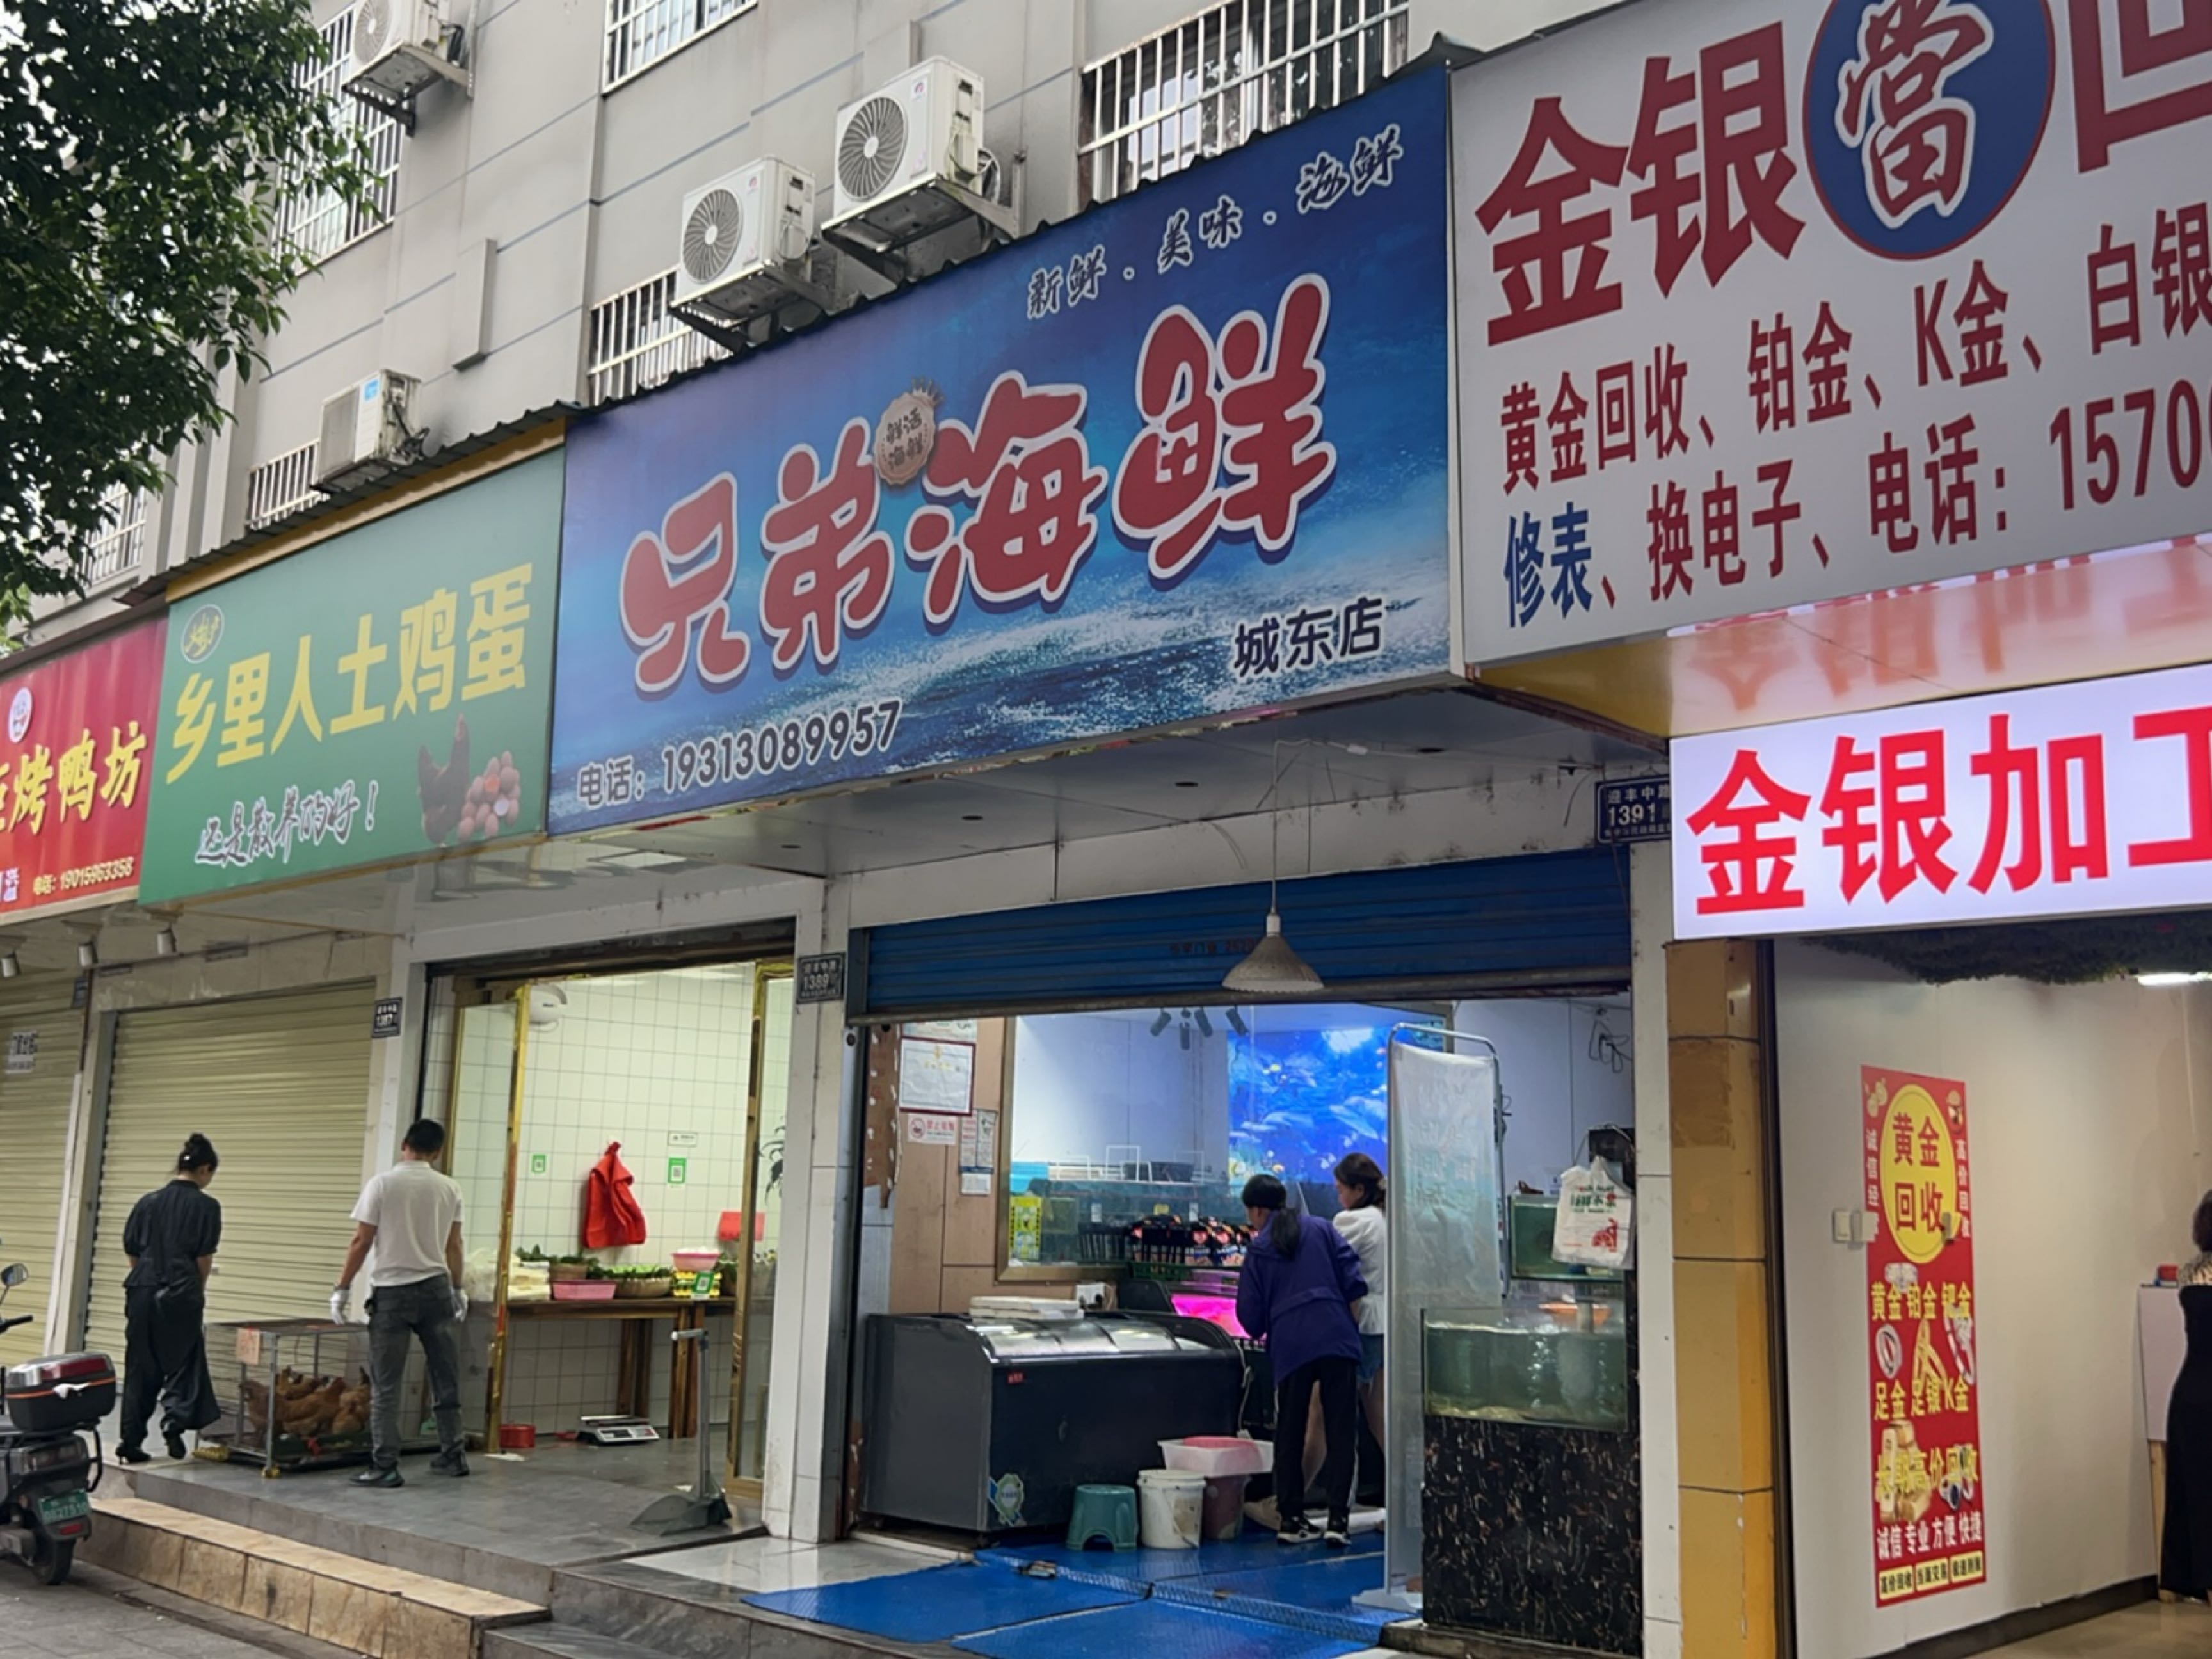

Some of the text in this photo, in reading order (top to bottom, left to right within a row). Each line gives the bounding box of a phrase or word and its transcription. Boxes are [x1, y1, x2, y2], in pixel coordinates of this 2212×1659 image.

[1475, 21, 1806, 346] 金银
[621, 274, 1336, 693] 兄弟海鲜
[1232, 597, 1384, 678] 城东店
[166, 563, 533, 785] 乡里人土鸡蛋
[1608, 802, 1655, 826] 1391
[1892, 1112, 1941, 1167] 黄金
[1894, 1181, 1945, 1233] 回收
[1874, 1379, 1906, 1421] 足金
